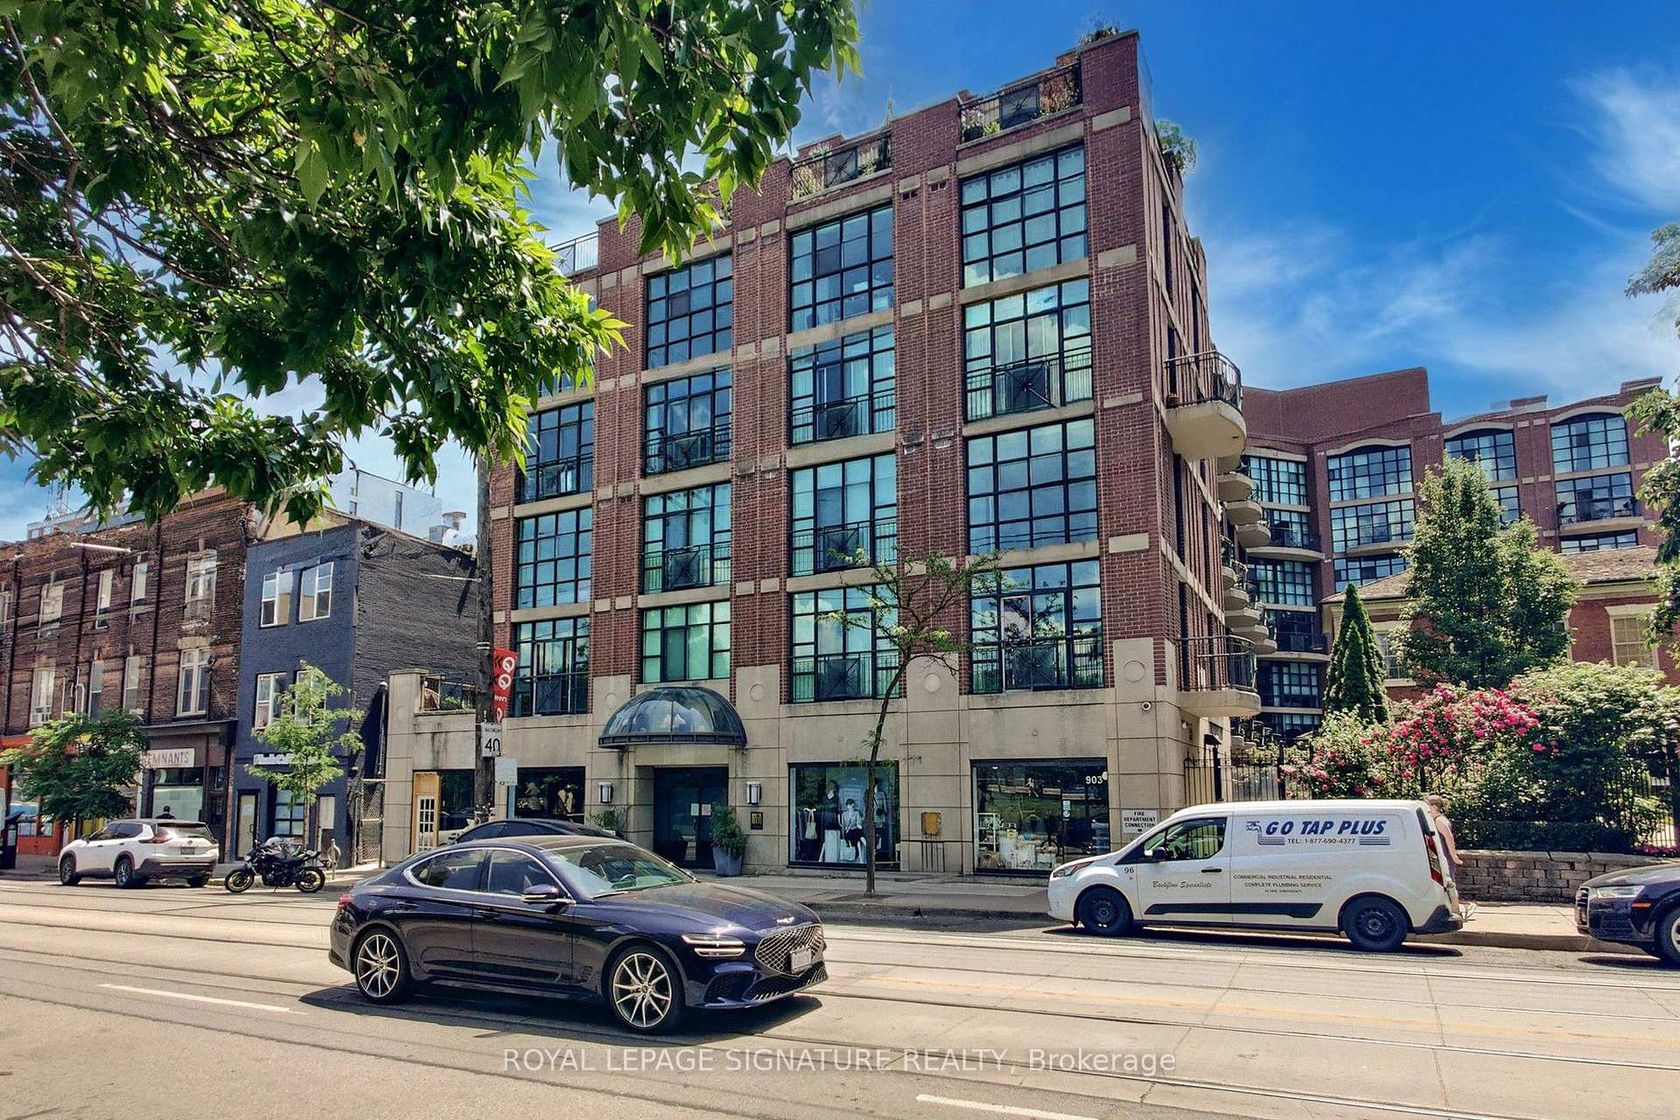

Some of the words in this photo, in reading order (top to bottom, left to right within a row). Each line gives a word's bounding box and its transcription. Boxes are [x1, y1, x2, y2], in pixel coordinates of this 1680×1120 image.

[483, 738, 501, 752] 40
[1085, 775, 1103, 784] 903
[1265, 820, 1294, 835] GO
[1300, 820, 1334, 835] TAP
[1337, 820, 1387, 835] PLUS
[1124, 866, 1135, 874] 96
